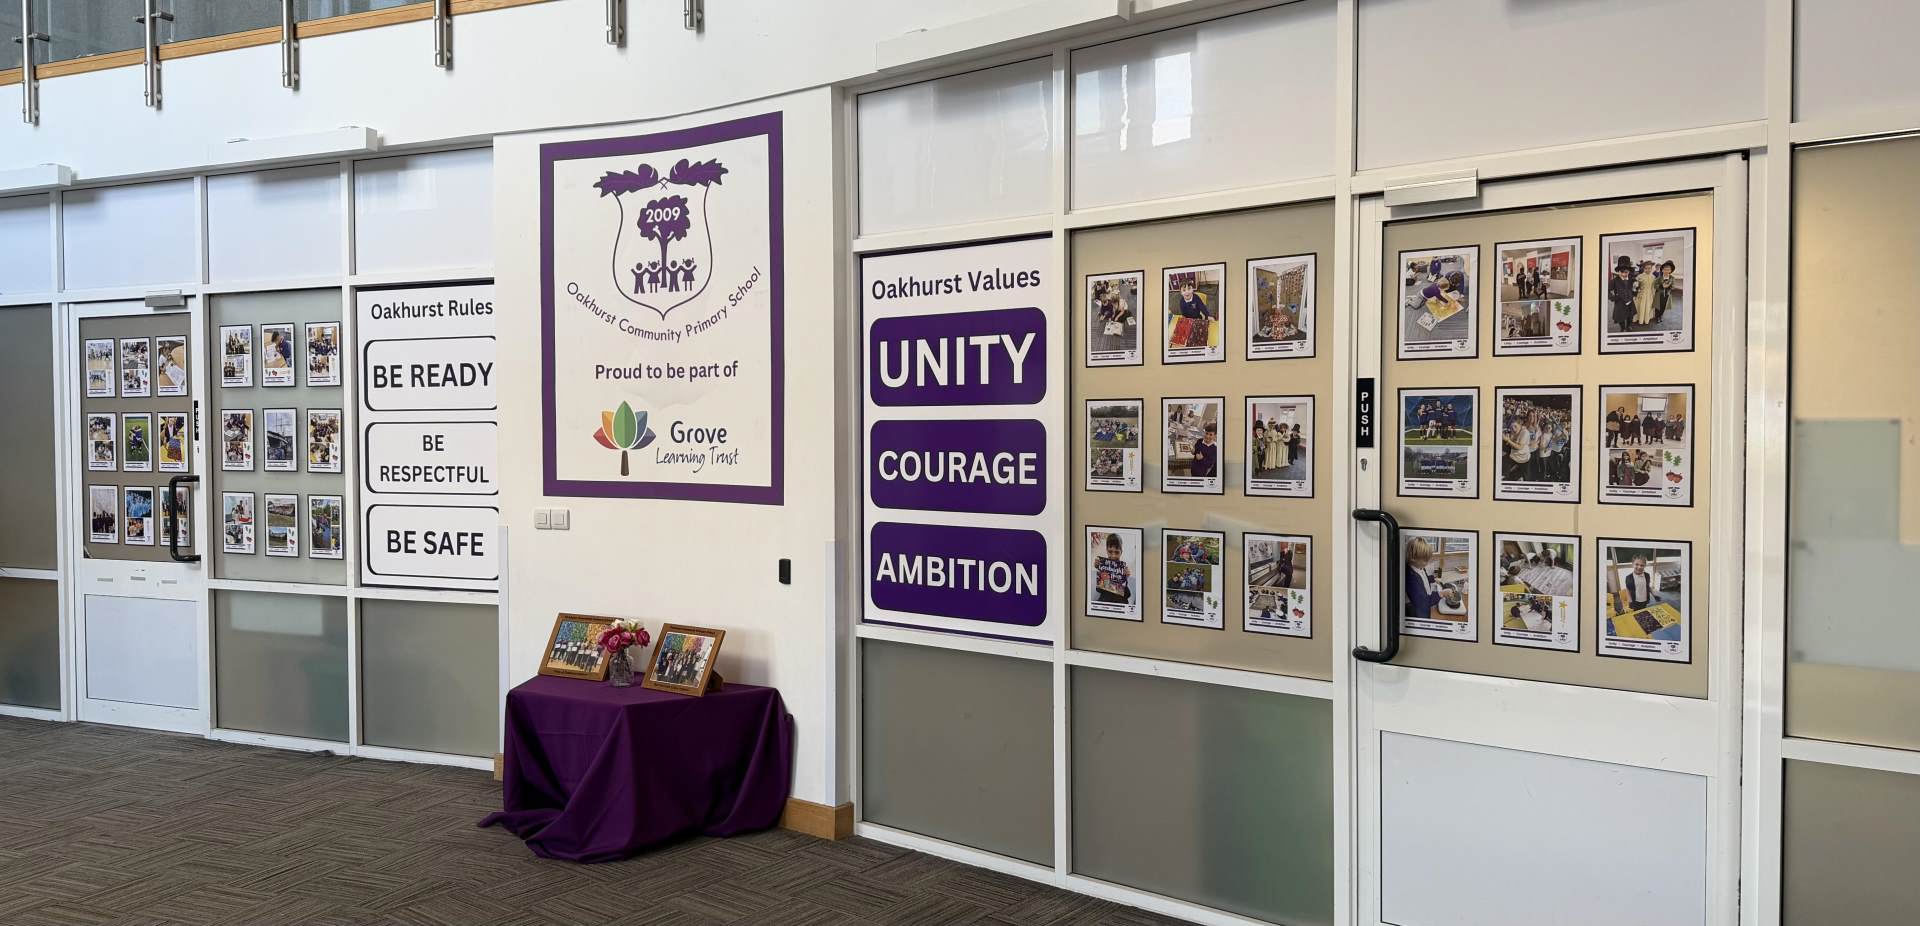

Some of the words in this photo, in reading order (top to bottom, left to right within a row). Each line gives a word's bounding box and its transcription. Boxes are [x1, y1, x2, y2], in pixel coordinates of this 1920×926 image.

[646, 206, 681, 223] 2009
[872, 274, 963, 300] Oakhurst
[968, 268, 1041, 292] Values
[371, 301, 444, 320] Oakhurst
[448, 298, 493, 317] Rules
[567, 282, 617, 325] Oakhurst
[619, 318, 681, 343] Community
[686, 305, 728, 337] Primary
[728, 266, 762, 307] School
[595, 363, 642, 379] Proud
[646, 364, 662, 379] to
[667, 362, 685, 379] be
[689, 363, 720, 382] part
[723, 360, 738, 377] of
[879, 332, 1037, 388] UNITY
[373, 364, 403, 388] BE
[410, 362, 493, 388] READY
[1361, 392, 1369, 436] PUSH
[422, 434, 445, 451] BE
[670, 420, 727, 444] Grove
[656, 447, 706, 473] Learning
[709, 446, 740, 465] Trust
[878, 450, 1038, 485] COURAGE
[380, 465, 489, 483] RESPECTFUL
[387, 529, 417, 554] BE
[423, 531, 484, 557] SAFE
[876, 552, 1038, 596] AMBITION
